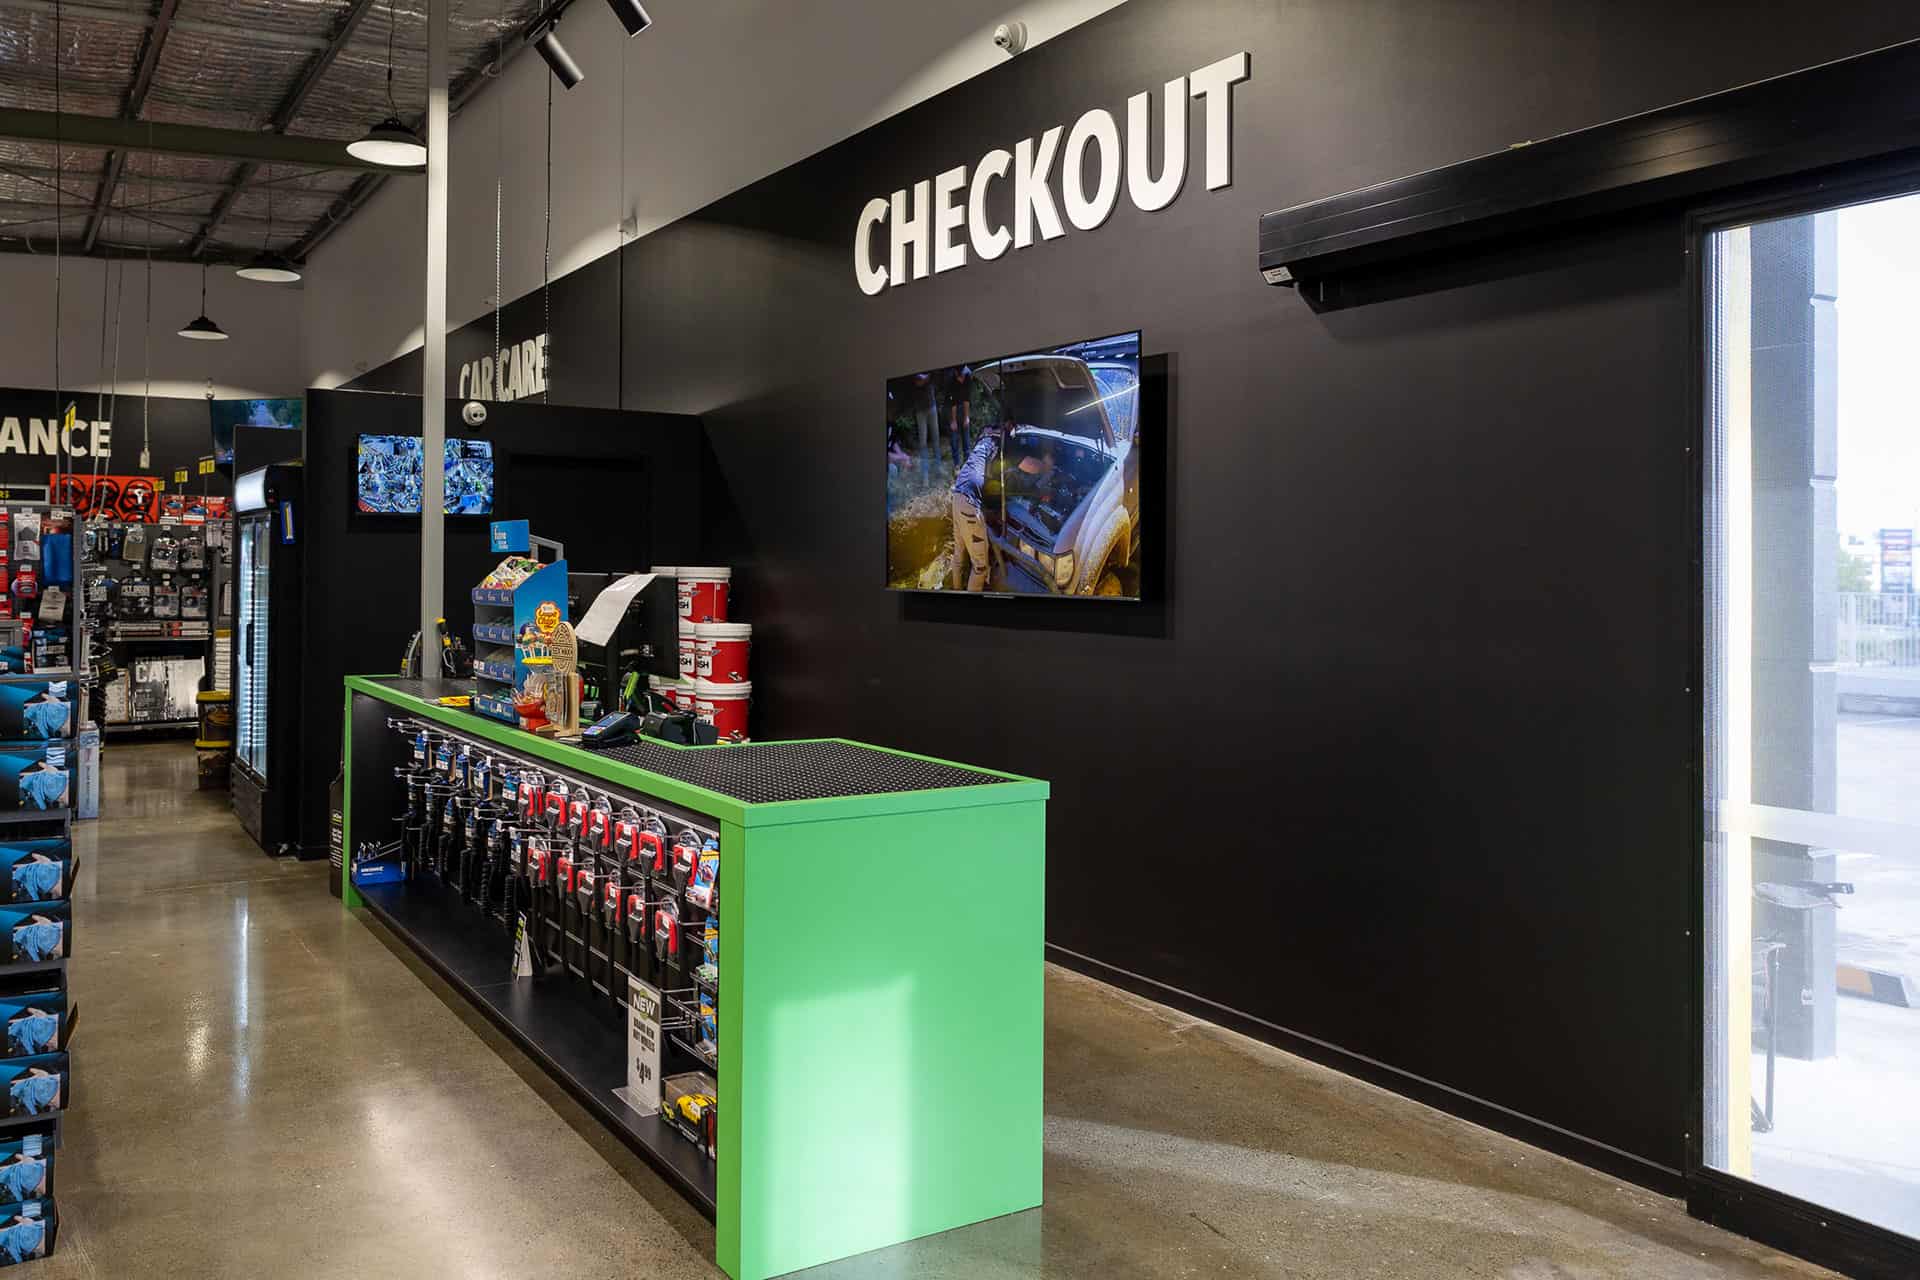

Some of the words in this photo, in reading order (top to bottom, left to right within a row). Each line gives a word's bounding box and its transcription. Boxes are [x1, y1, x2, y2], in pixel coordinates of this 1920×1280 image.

[854, 51, 1250, 296] CHECKOUT
[459, 356, 494, 400] CAR
[499, 333, 548, 402] CARE
[0, 416, 111, 457] ANCE
[633, 993, 655, 1016] NEW
